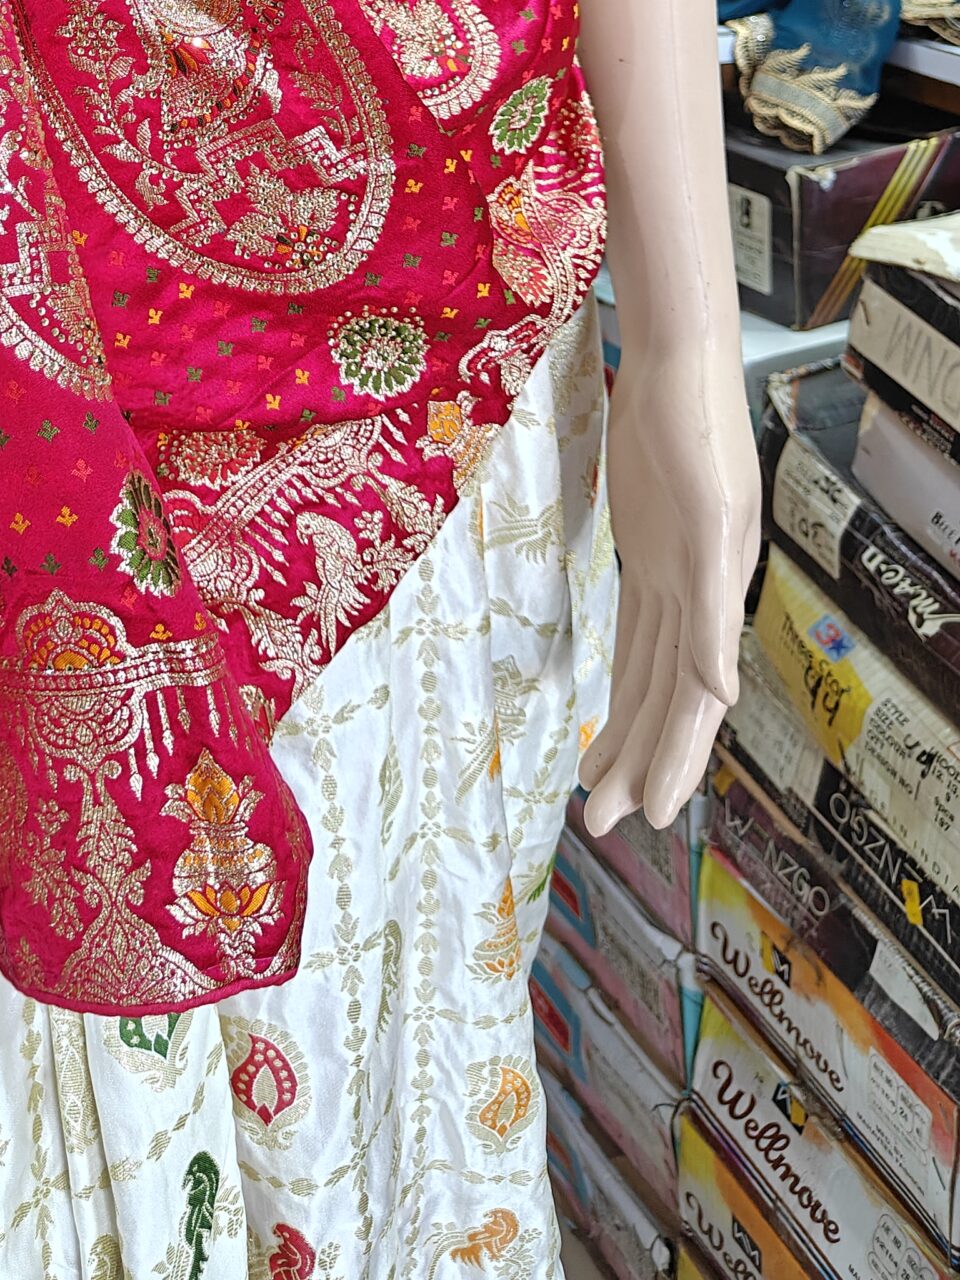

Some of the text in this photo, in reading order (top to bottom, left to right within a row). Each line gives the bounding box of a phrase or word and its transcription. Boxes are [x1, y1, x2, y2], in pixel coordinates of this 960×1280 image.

[874, 706, 894, 730] SIZE
[882, 698, 909, 727] STYLE
[710, 920, 845, 1093] Wellmove
[712, 1060, 840, 1244] Wellmove
